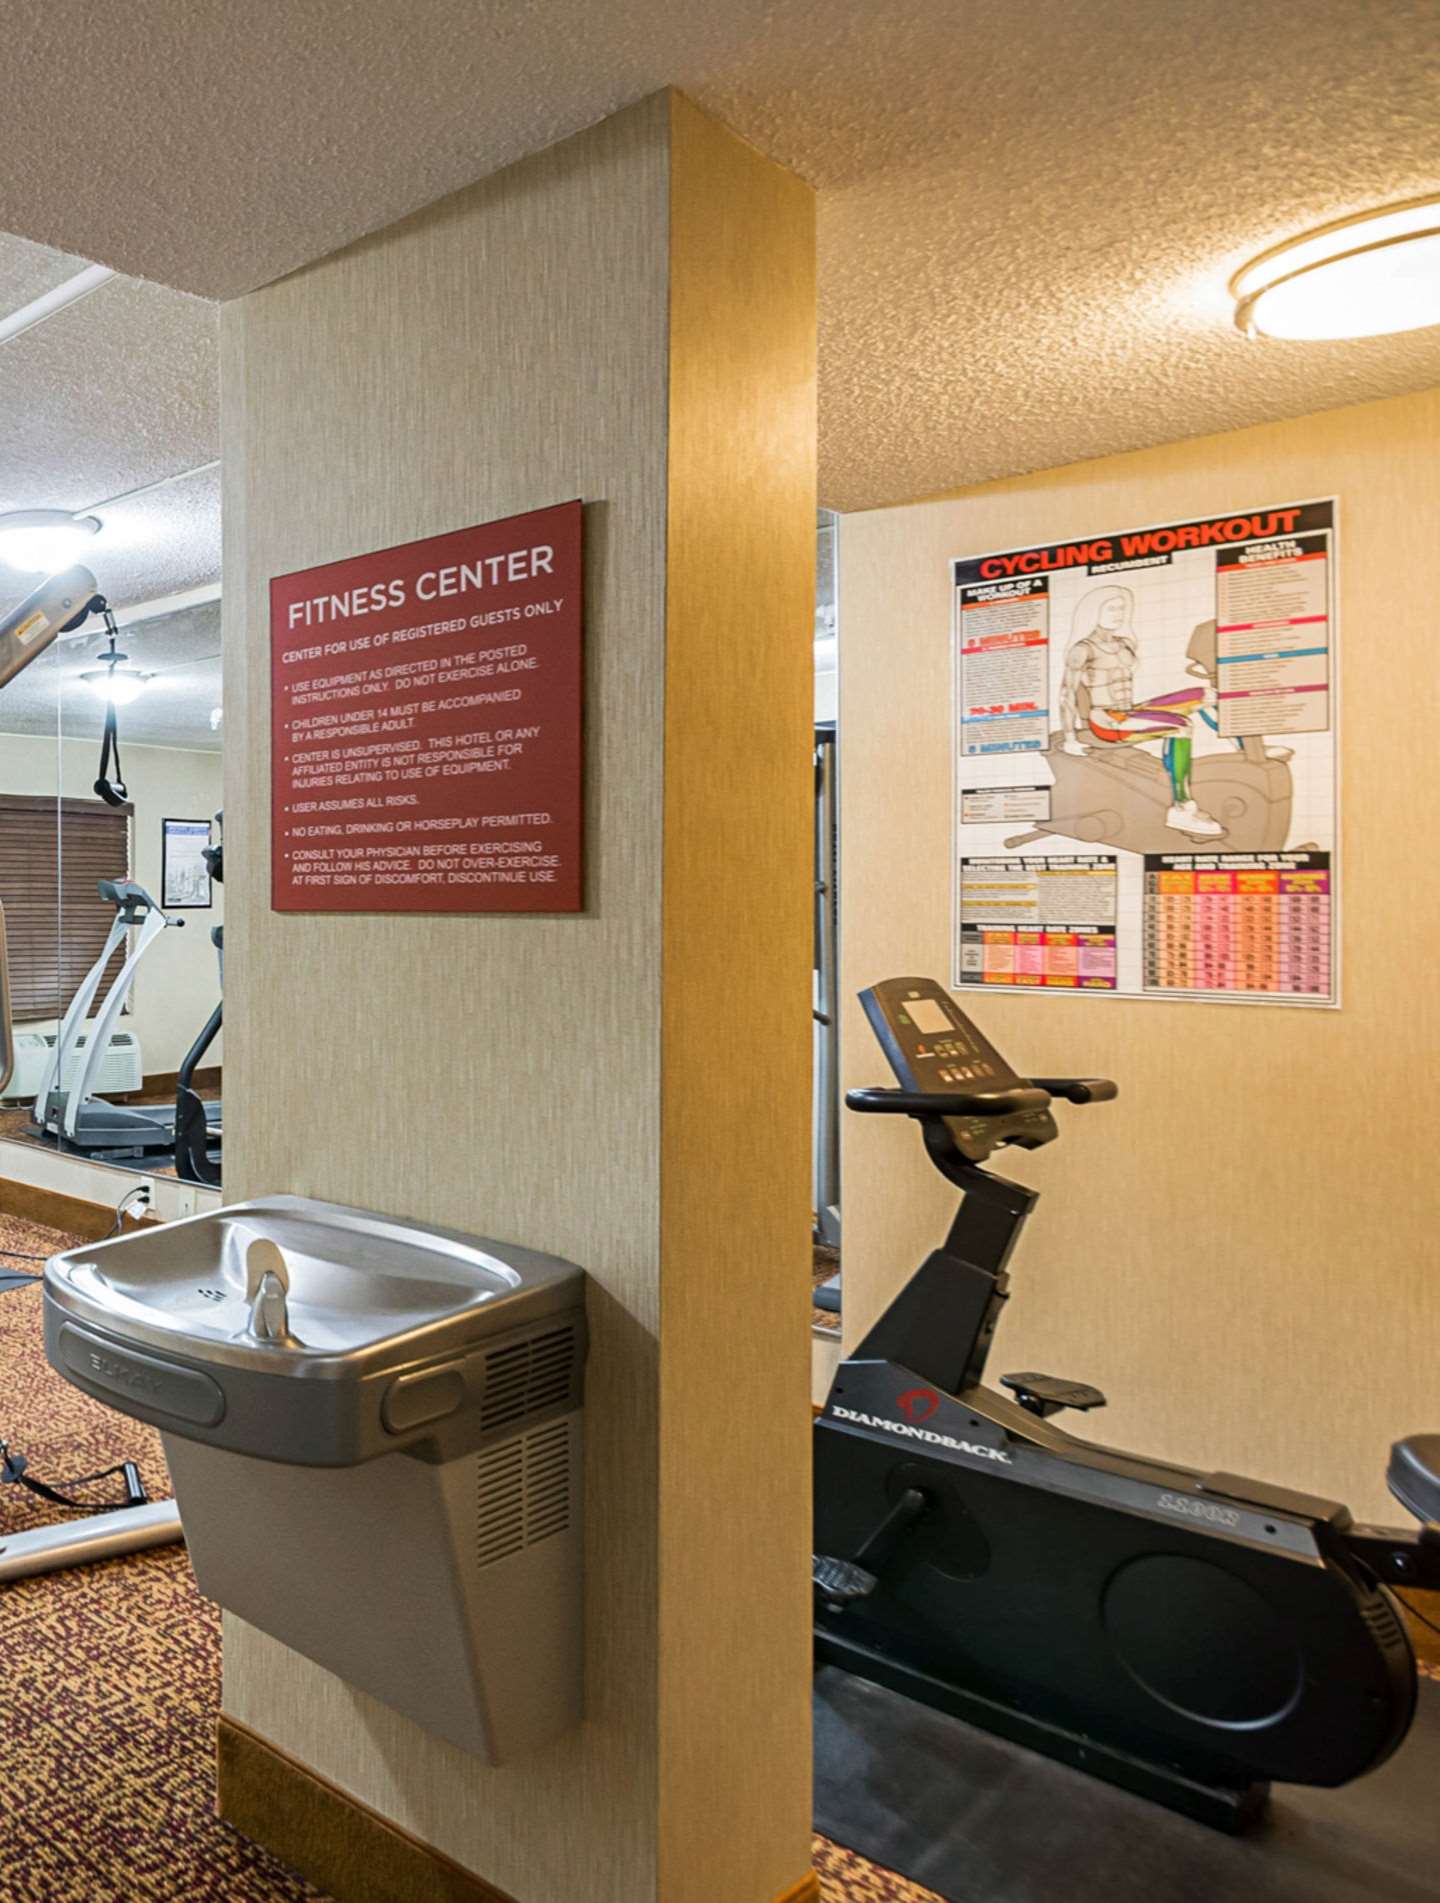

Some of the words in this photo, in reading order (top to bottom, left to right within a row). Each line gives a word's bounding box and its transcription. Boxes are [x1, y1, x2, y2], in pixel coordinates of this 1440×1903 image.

[980, 540, 1113, 579] CYCLING
[1120, 509, 1302, 557] WORKOUT
[1245, 540, 1297, 555] HEALTH
[1091, 555, 1169, 574] RECUMBENT
[1238, 548, 1304, 564] BENEFITS
[288, 580, 406, 627] FITNESS
[415, 546, 554, 600] CENTER
[967, 585, 998, 597] MAKE
[998, 582, 1014, 594] UP
[1015, 580, 1033, 591] OF
[1033, 578, 1043, 587] A
[976, 588, 1032, 602] WORKOUT
[281, 646, 321, 663] CENTER
[324, 641, 346, 655] FOR
[349, 636, 370, 650] USE
[373, 633, 389, 646] OF
[392, 618, 465, 642] REGISTERED
[469, 607, 520, 627] GUESTS
[524, 598, 563, 617] ONLY
[291, 681, 309, 692] USE
[312, 671, 367, 689] EQUIPMENT
[368, 668, 382, 680] AS
[385, 659, 436, 677] DIRECTED
[440, 657, 450, 668] IN
[454, 652, 475, 666] THE
[479, 644, 527, 661] POSTED
[291, 685, 359, 704] INSTRUCTIONS
[395, 677, 411, 688] DO
[413, 673, 434, 686] NOT
[438, 664, 493, 682] EXERCISE
[291, 714, 337, 729] CHILDREN
[340, 709, 374, 722] UNDER
[377, 707, 387, 717] 14
[390, 703, 418, 716] MUST
[422, 701, 435, 711] BE
[438, 688, 521, 709] ACCOMPANIED
[291, 732, 304, 741] BY
[305, 731, 311, 740] A
[313, 722, 380, 739] RESPONSIBLE
[291, 750, 328, 763] CENTER
[331, 749, 339, 758] IS
[428, 736, 452, 748] THIS
[455, 732, 491, 745] HOTEL
[495, 729, 513, 741] OR
[514, 726, 540, 738] ANY
[291, 762, 342, 775] AFFILIATED
[344, 758, 379, 770] ENTITY
[382, 757, 391, 766] IS
[393, 754, 415, 765] NOT
[417, 746, 494, 763] RESPONSIBLE
[497, 743, 522, 755] FOR
[292, 776, 333, 788] INJURIES
[335, 771, 382, 784] RELATING
[385, 770, 398, 779] TO
[401, 767, 422, 778] USE
[425, 766, 439, 776] OF
[292, 802, 316, 812] USER
[319, 798, 364, 810] ASSUMES
[366, 797, 383, 807] ALL
[386, 794, 419, 805] RISKS.
[292, 827, 305, 836] NO
[346, 822, 393, 833] DRINKING
[396, 821, 412, 831] OR
[415, 817, 479, 830] HORSEPLAY
[292, 849, 334, 859] CONSULT
[337, 848, 363, 857] YOUR
[366, 846, 419, 856] PHYSICIAN
[423, 844, 467, 854] BEFORE
[470, 841, 541, 853] EXERCISING
[292, 863, 311, 872] AND
[313, 862, 351, 871] FOLLOW
[355, 861, 370, 870] HIS
[417, 859, 434, 869] DO
[437, 858, 459, 868] NOT
[292, 876, 302, 884] AT
[304, 875, 331, 884] FIRST
[333, 875, 356, 884] SIGN
[359, 875, 372, 883] OF
[447, 872, 526, 882] DISCONTINUE
[831, 1405, 1010, 1464] DIAMONDBACK
